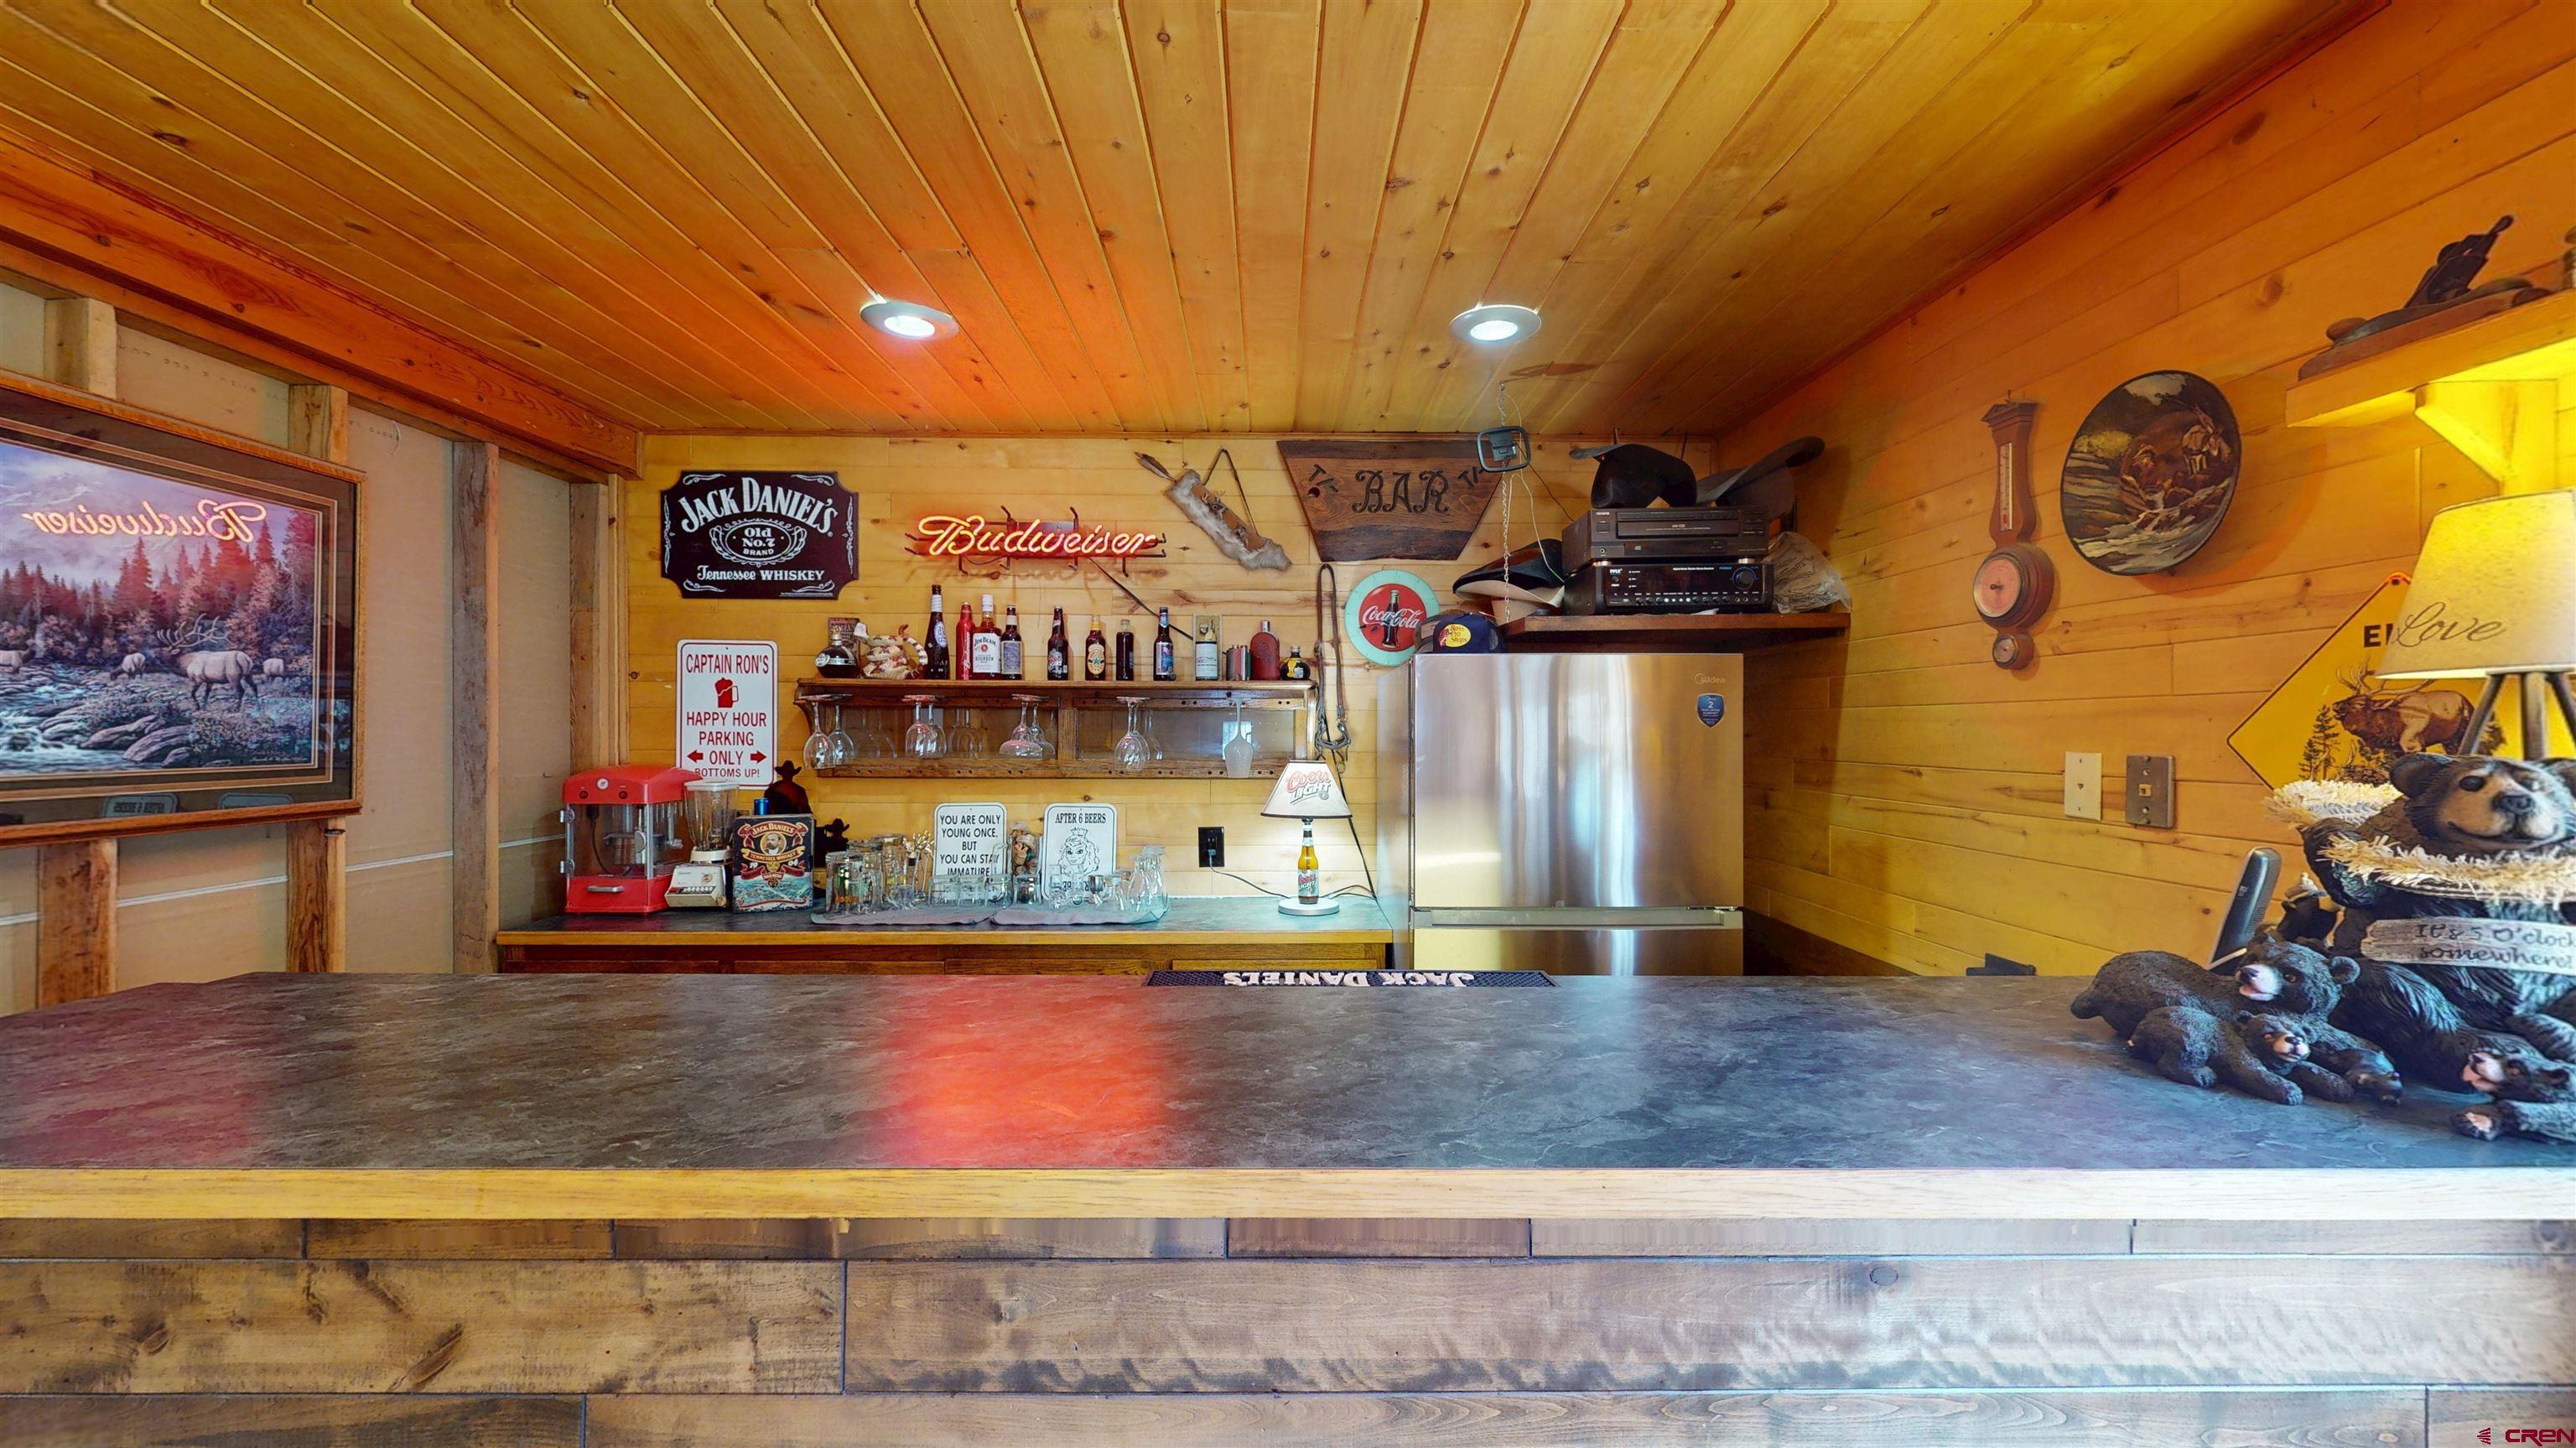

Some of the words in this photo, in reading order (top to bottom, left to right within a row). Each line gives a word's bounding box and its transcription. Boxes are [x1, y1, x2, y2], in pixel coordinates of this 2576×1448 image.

[1352, 470, 1450, 513] BAR
[678, 486, 740, 533] JACK
[741, 476, 838, 534] DANIEL'S
[744, 527, 772, 537] Old
[917, 514, 1159, 557] Budweiser
[742, 537, 776, 548] No.7
[743, 548, 775, 557] BRAND
[697, 564, 756, 581] Tennessee
[761, 569, 824, 581] WHISKEY
[1362, 605, 1424, 629] Coca-Cola
[2392, 601, 2507, 648] Love
[983, 636, 996, 646] BEAM
[686, 654, 732, 674] CAPTAIN
[736, 655, 769, 674] RON'S
[686, 712, 728, 726] HAPPY
[732, 712, 767, 727] HOUR
[699, 731, 754, 746] PARKING
[709, 750, 744, 766] ONLY
[694, 768, 741, 777] BOTTOMS
[745, 768, 760, 778] UP!
[1286, 770, 1331, 792] Coors
[1291, 781, 1332, 801] LIGHT
[940, 815, 958, 825] YOU
[960, 815, 976, 825] ARE
[978, 814, 1001, 825] ONLY
[1055, 812, 1077, 823] AFTER
[1078, 812, 1083, 823] 6
[1084, 812, 1107, 824] BEERS
[751, 825, 768, 835] JACK
[942, 828, 971, 838] YOUNG
[962, 841, 977, 851] BUT
[940, 854, 958, 864] YOU
[960, 854, 977, 864] CAN
[1223, 971, 1370, 987] DANIEL'S
[1382, 971, 1474, 987] JACK
